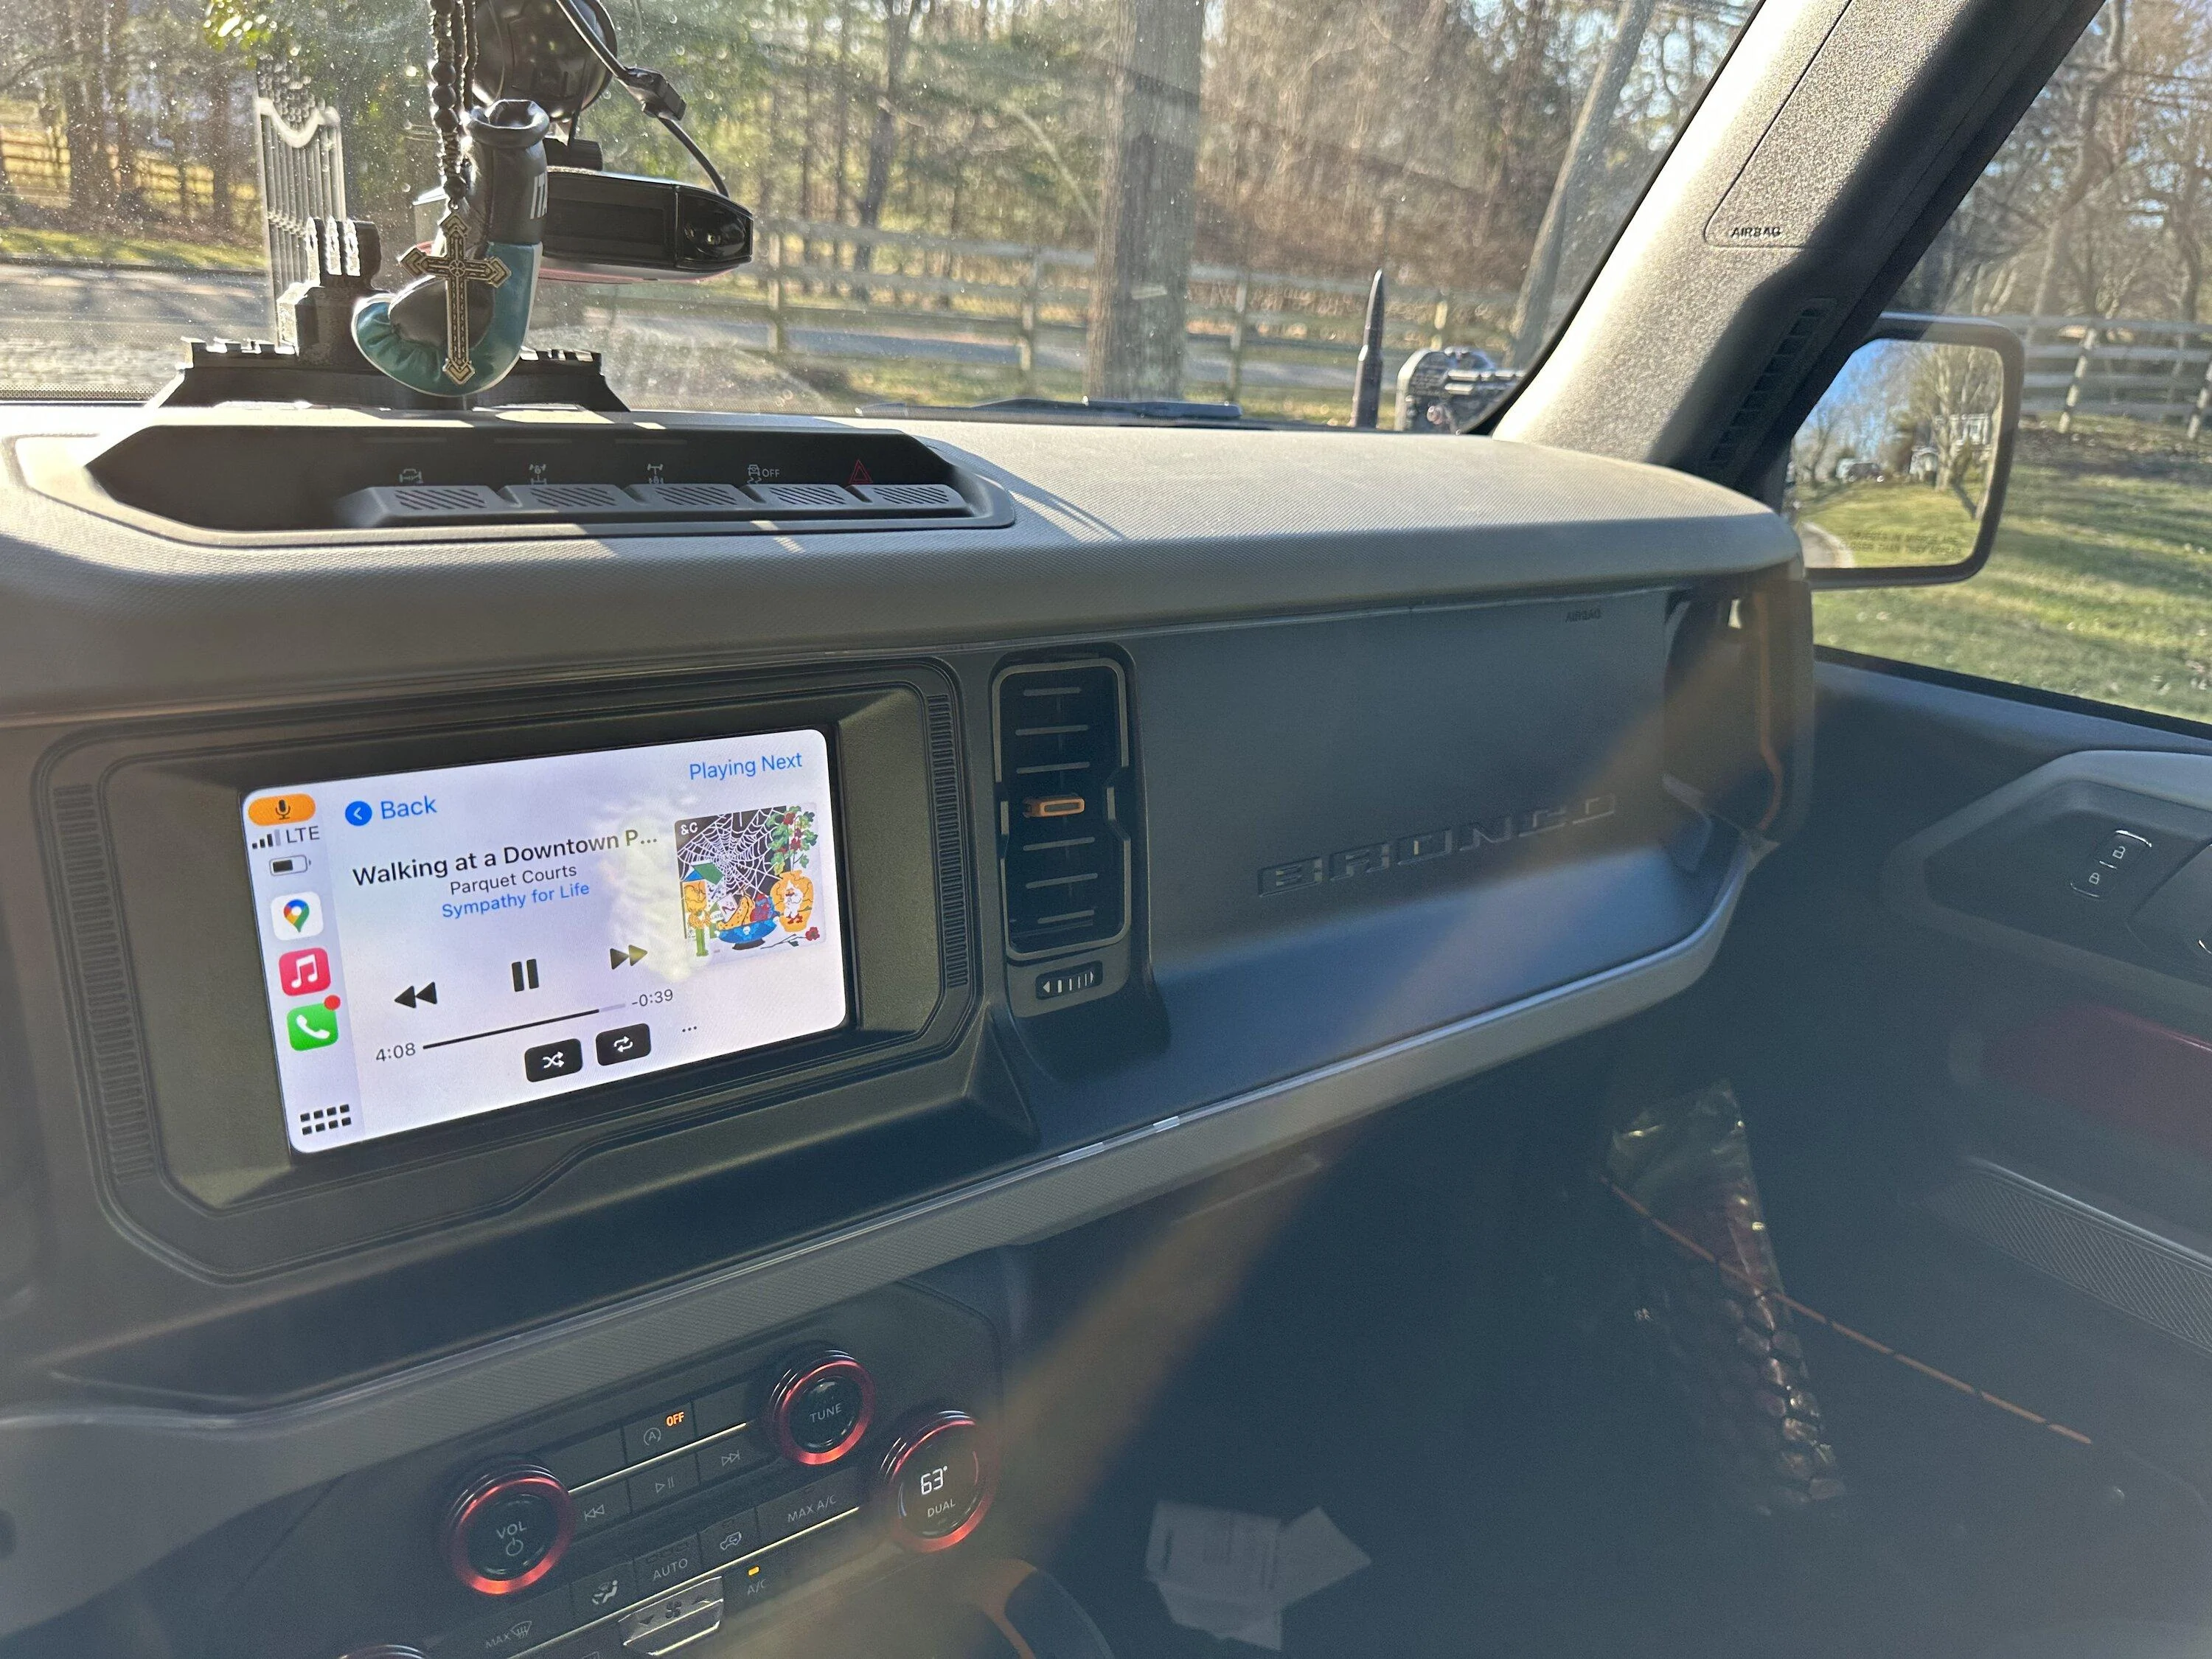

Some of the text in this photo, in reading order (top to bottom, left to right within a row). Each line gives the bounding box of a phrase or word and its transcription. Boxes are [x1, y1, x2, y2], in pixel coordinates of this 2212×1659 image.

[1731, 226, 1781, 237] AIRBAG
[762, 468, 780, 477] OFF
[689, 752, 803, 781] Playing Next
[380, 796, 437, 819] Back
[286, 826, 320, 844] LTE
[1257, 793, 1616, 898] BRONCO
[352, 858, 448, 886] Walking
[455, 852, 477, 872] at
[484, 853, 497, 867] a
[504, 835, 619, 864] Downtown
[450, 865, 577, 895] Parquet Courts
[442, 882, 590, 919] Sympathy for Life
[631, 989, 674, 1008] -0:39
[375, 1043, 416, 1062] 4:08
[666, 1411, 684, 1427] OFF
[810, 1402, 842, 1423] TUNE
[787, 1494, 838, 1523] MAX A/C
[927, 1498, 956, 1518] DUAL
[496, 1520, 527, 1540] VOL
[653, 1558, 688, 1582] AUTO
[747, 1578, 768, 1596] A/C
[485, 1632, 512, 1649] MAX
